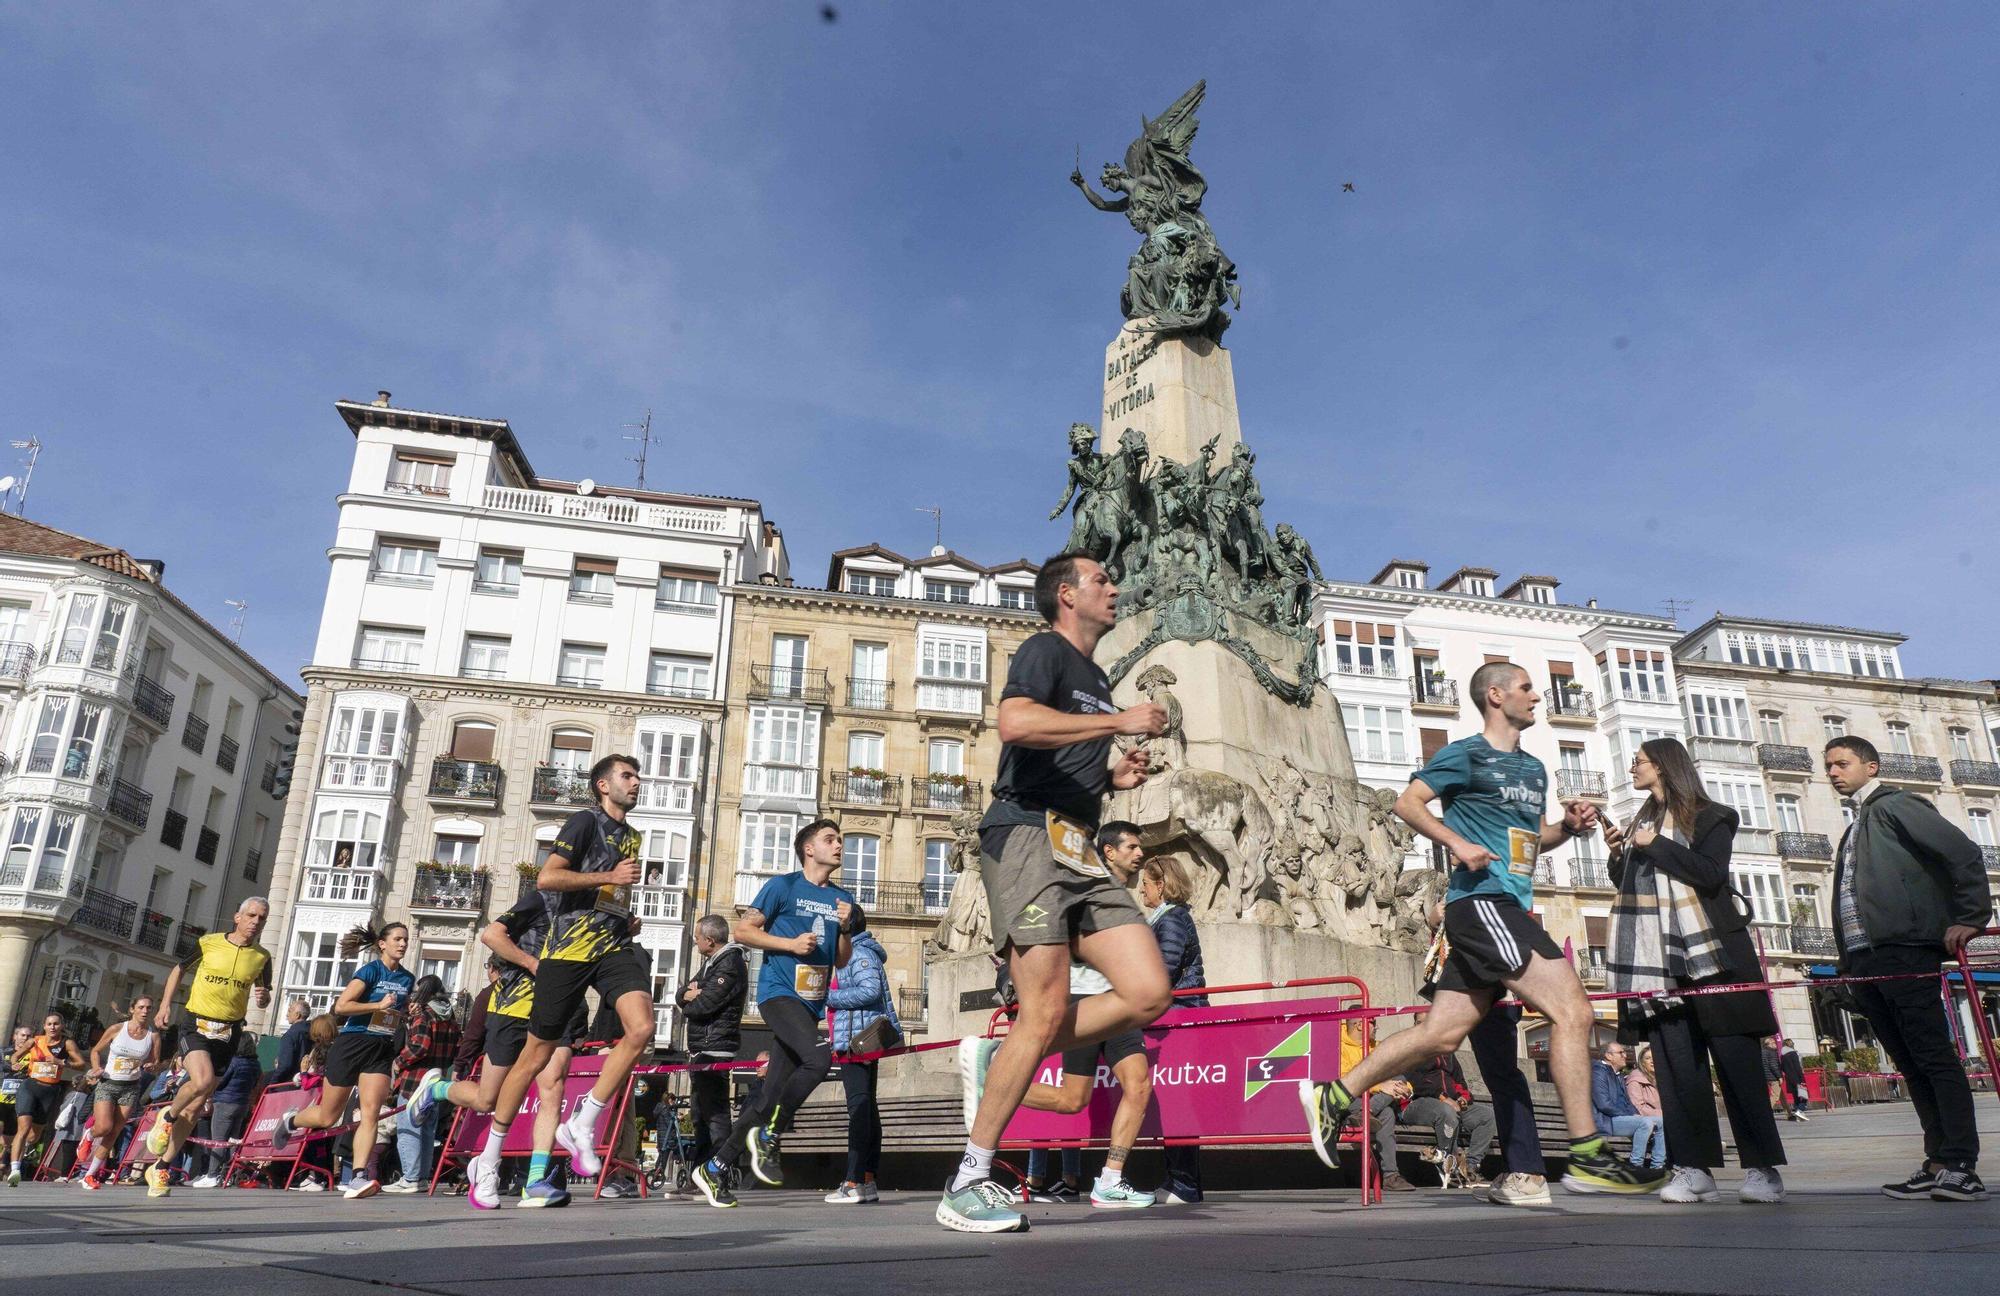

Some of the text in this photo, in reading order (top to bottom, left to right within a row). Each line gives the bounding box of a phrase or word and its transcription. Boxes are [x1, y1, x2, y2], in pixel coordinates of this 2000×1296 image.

[1126, 372, 1138, 390] DE
[1109, 382, 1155, 421] VITORIA
[205, 974, 229, 986] 42195
[1152, 1062, 1226, 1086] kutxa
